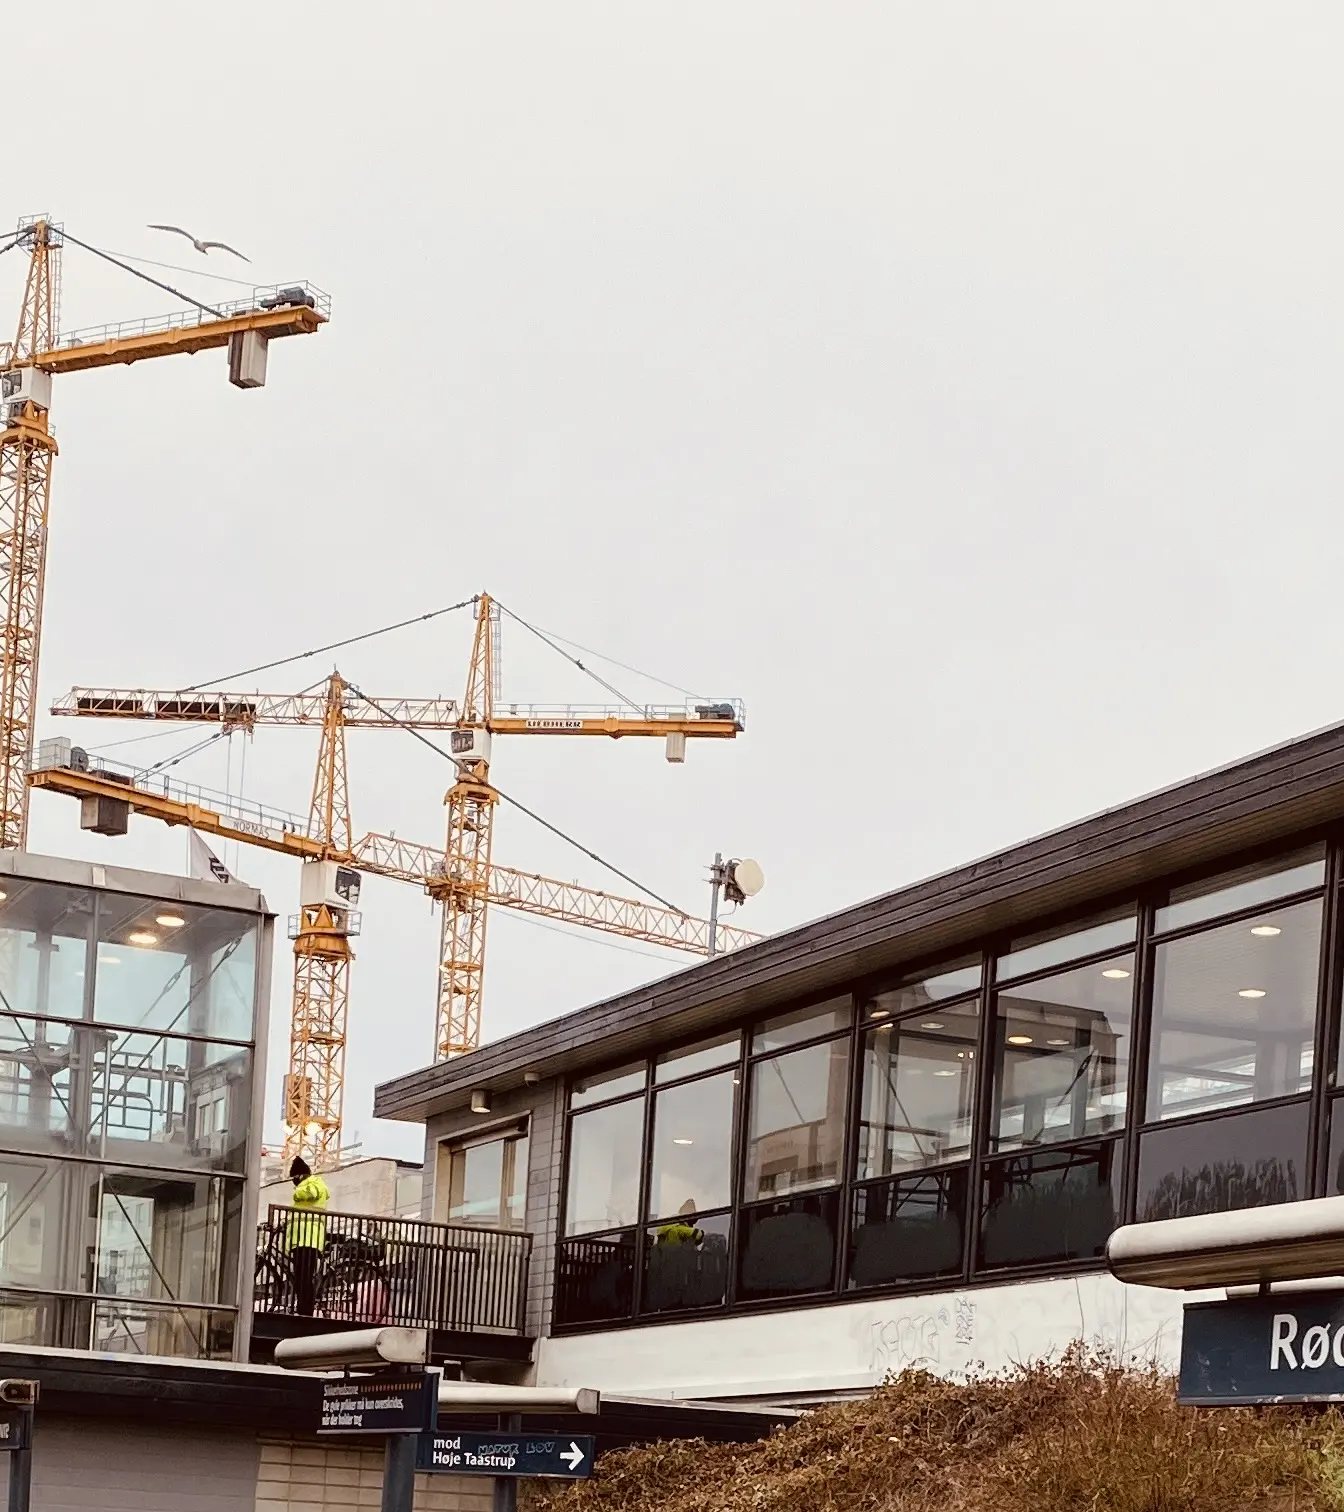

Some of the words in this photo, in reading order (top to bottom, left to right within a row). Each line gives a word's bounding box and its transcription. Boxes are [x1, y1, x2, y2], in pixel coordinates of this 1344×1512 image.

[233, 821, 270, 840] NORMAS
[433, 1436, 461, 1450] mod
[432, 1451, 461, 1467] Høje
[464, 1452, 516, 1470] Taastrup
